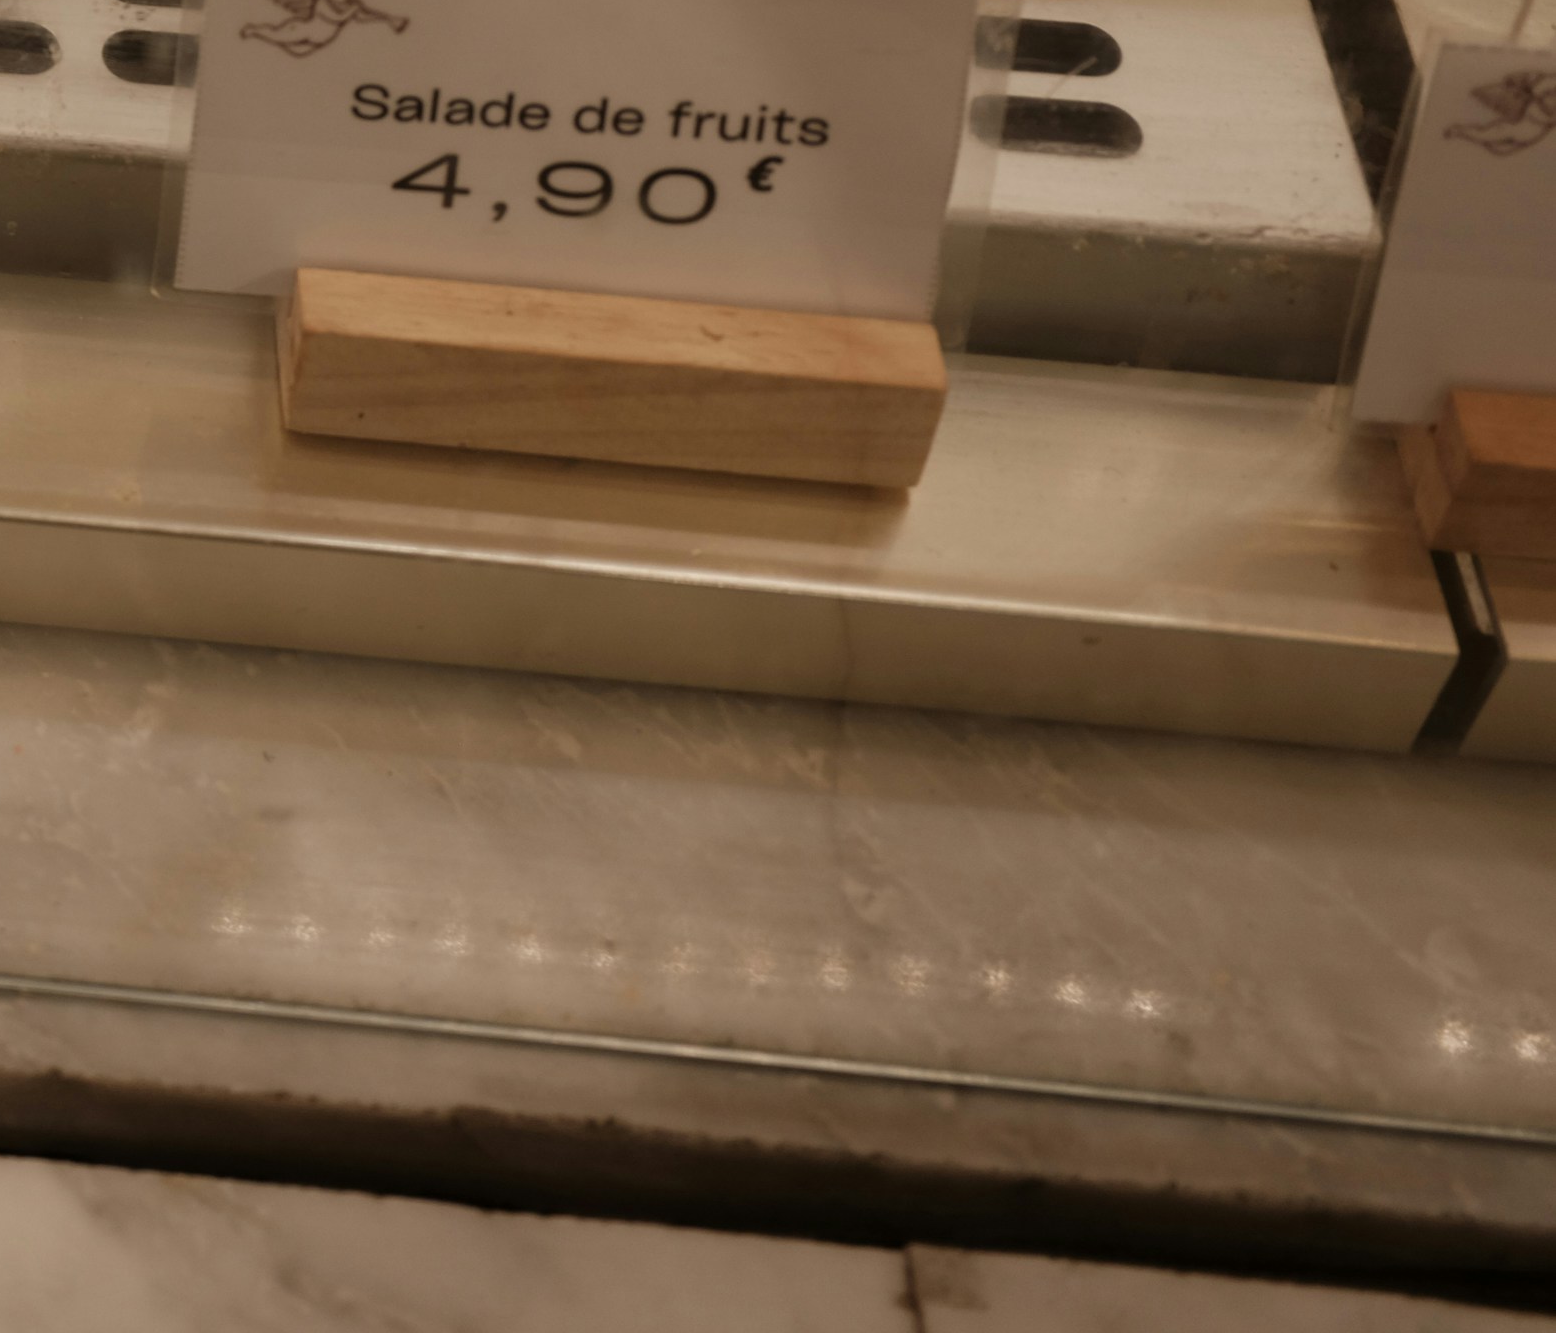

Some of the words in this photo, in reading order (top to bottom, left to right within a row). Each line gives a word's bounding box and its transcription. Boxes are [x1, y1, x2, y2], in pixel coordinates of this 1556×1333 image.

[350, 82, 552, 133] Salade
[571, 96, 646, 138] de
[667, 99, 830, 148] fruits
